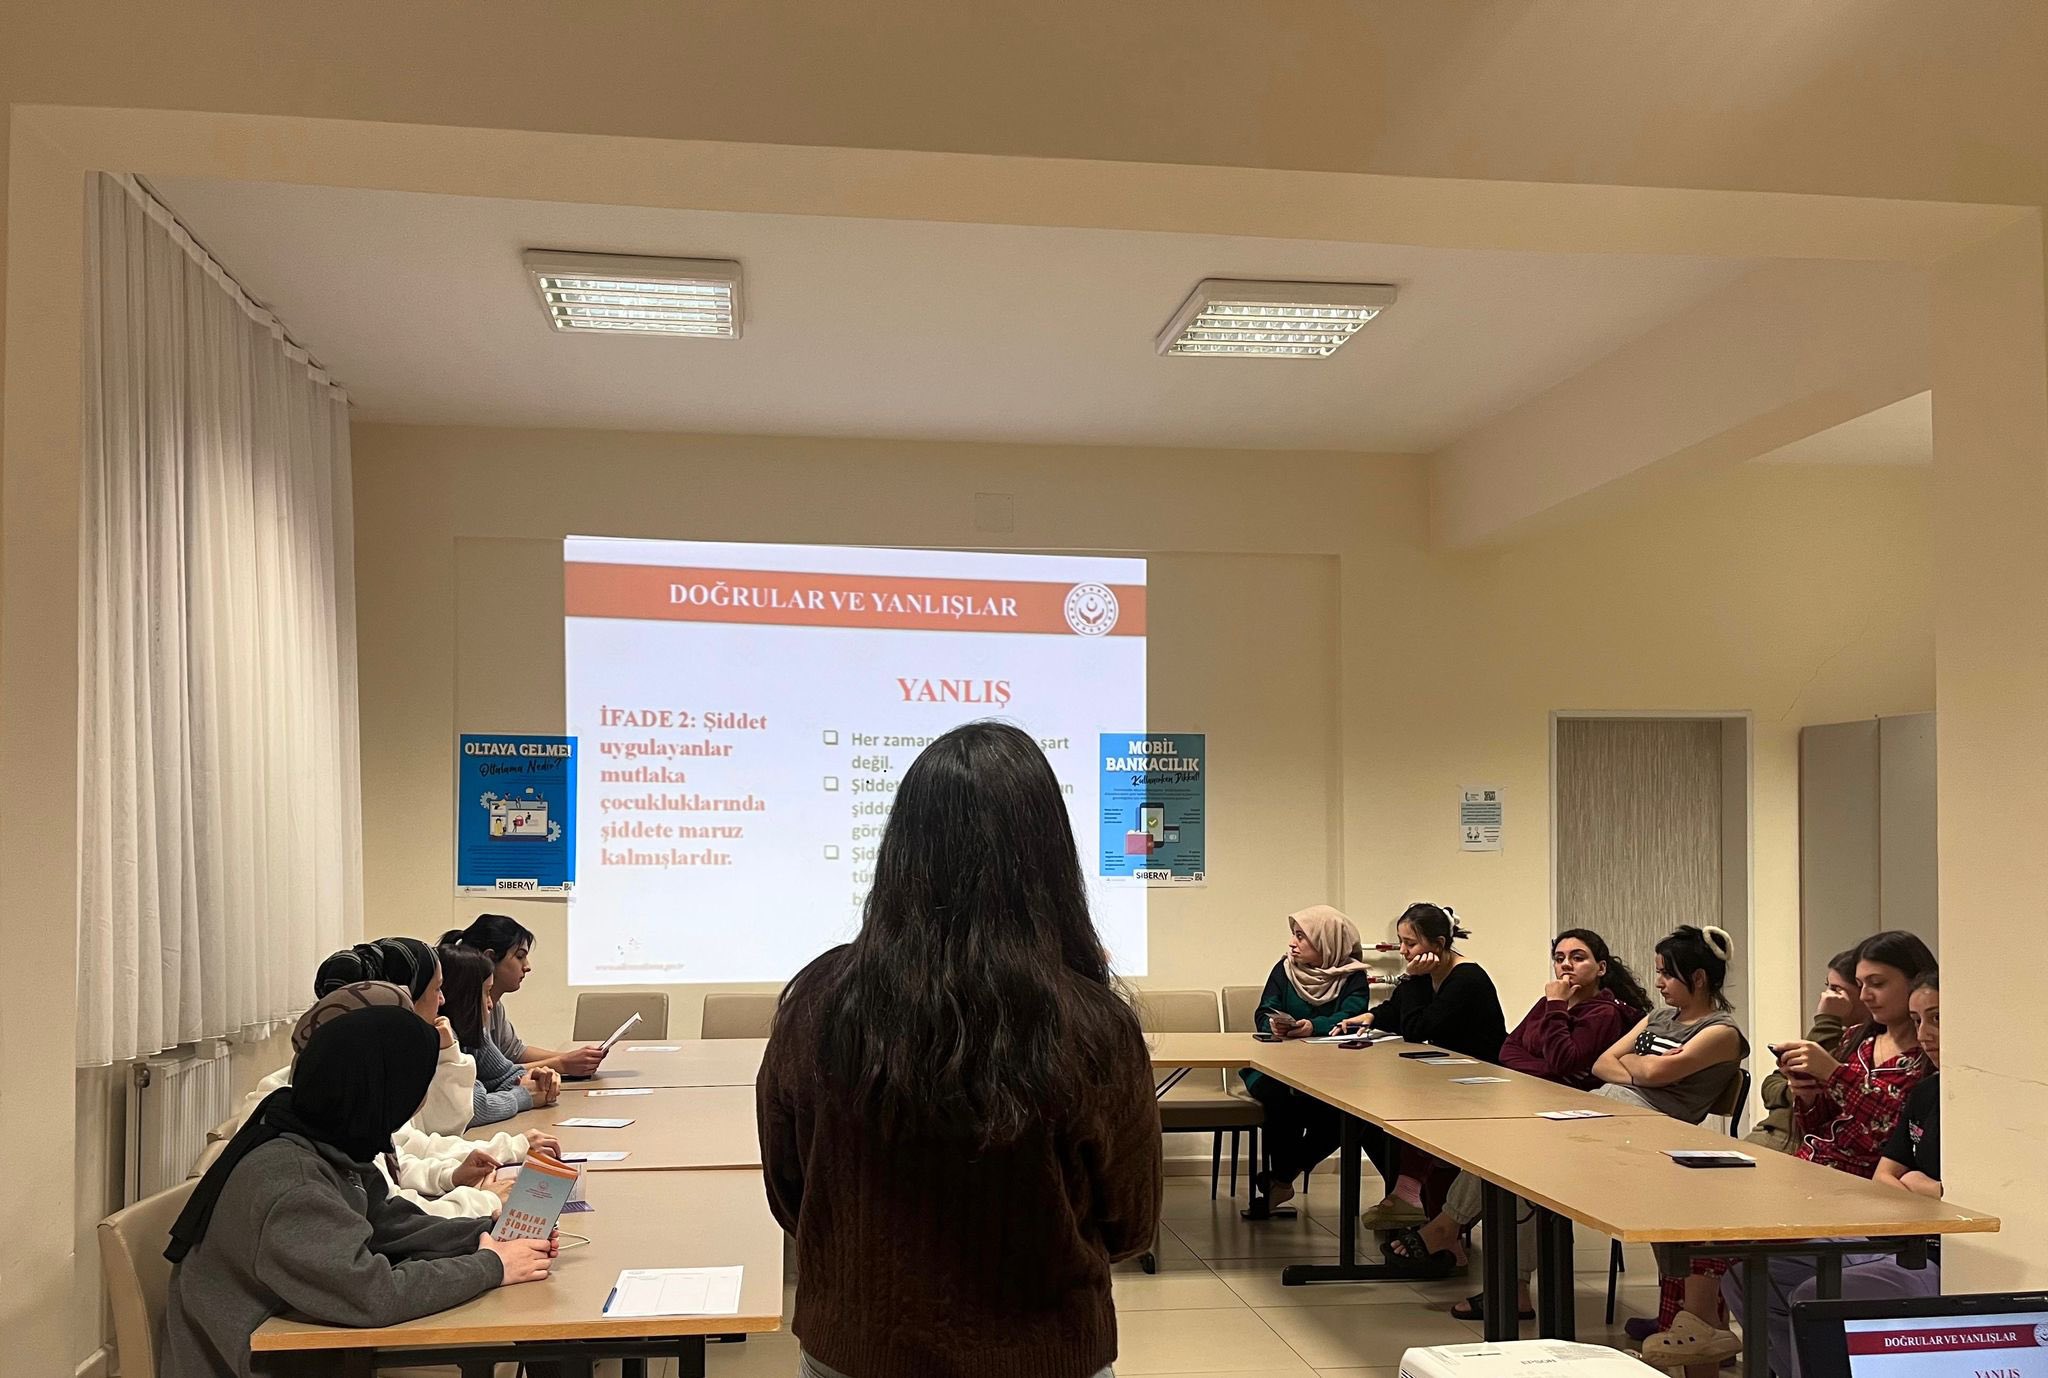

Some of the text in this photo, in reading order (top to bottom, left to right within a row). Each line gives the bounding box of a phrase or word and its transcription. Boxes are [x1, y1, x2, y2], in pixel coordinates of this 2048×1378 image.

[669, 581, 1019, 619] DOĞRULAR VE YANLIŞLAR
[896, 677, 1012, 709] YANLIŞ
[600, 705, 768, 733] İFADE 2: Şiddet
[464, 742, 572, 757] OLTAYA GELME!
[600, 738, 734, 761] uygulayanlar
[851, 733, 880, 746] Her
[1040, 737, 1070, 752] şart
[1128, 737, 1178, 755] MOBİL
[851, 755, 894, 773] değil.
[1105, 757, 1200, 772] BANKACILIK
[600, 766, 687, 784] mutlaka
[600, 793, 767, 814] çocukluklarında
[600, 820, 744, 843] şiddete maruz
[600, 848, 732, 870] kalmışlardır.
[508, 1208, 547, 1226] KADINA
[1884, 1332, 2017, 1348] DOĞRULAR VE YANLIŞLAR
